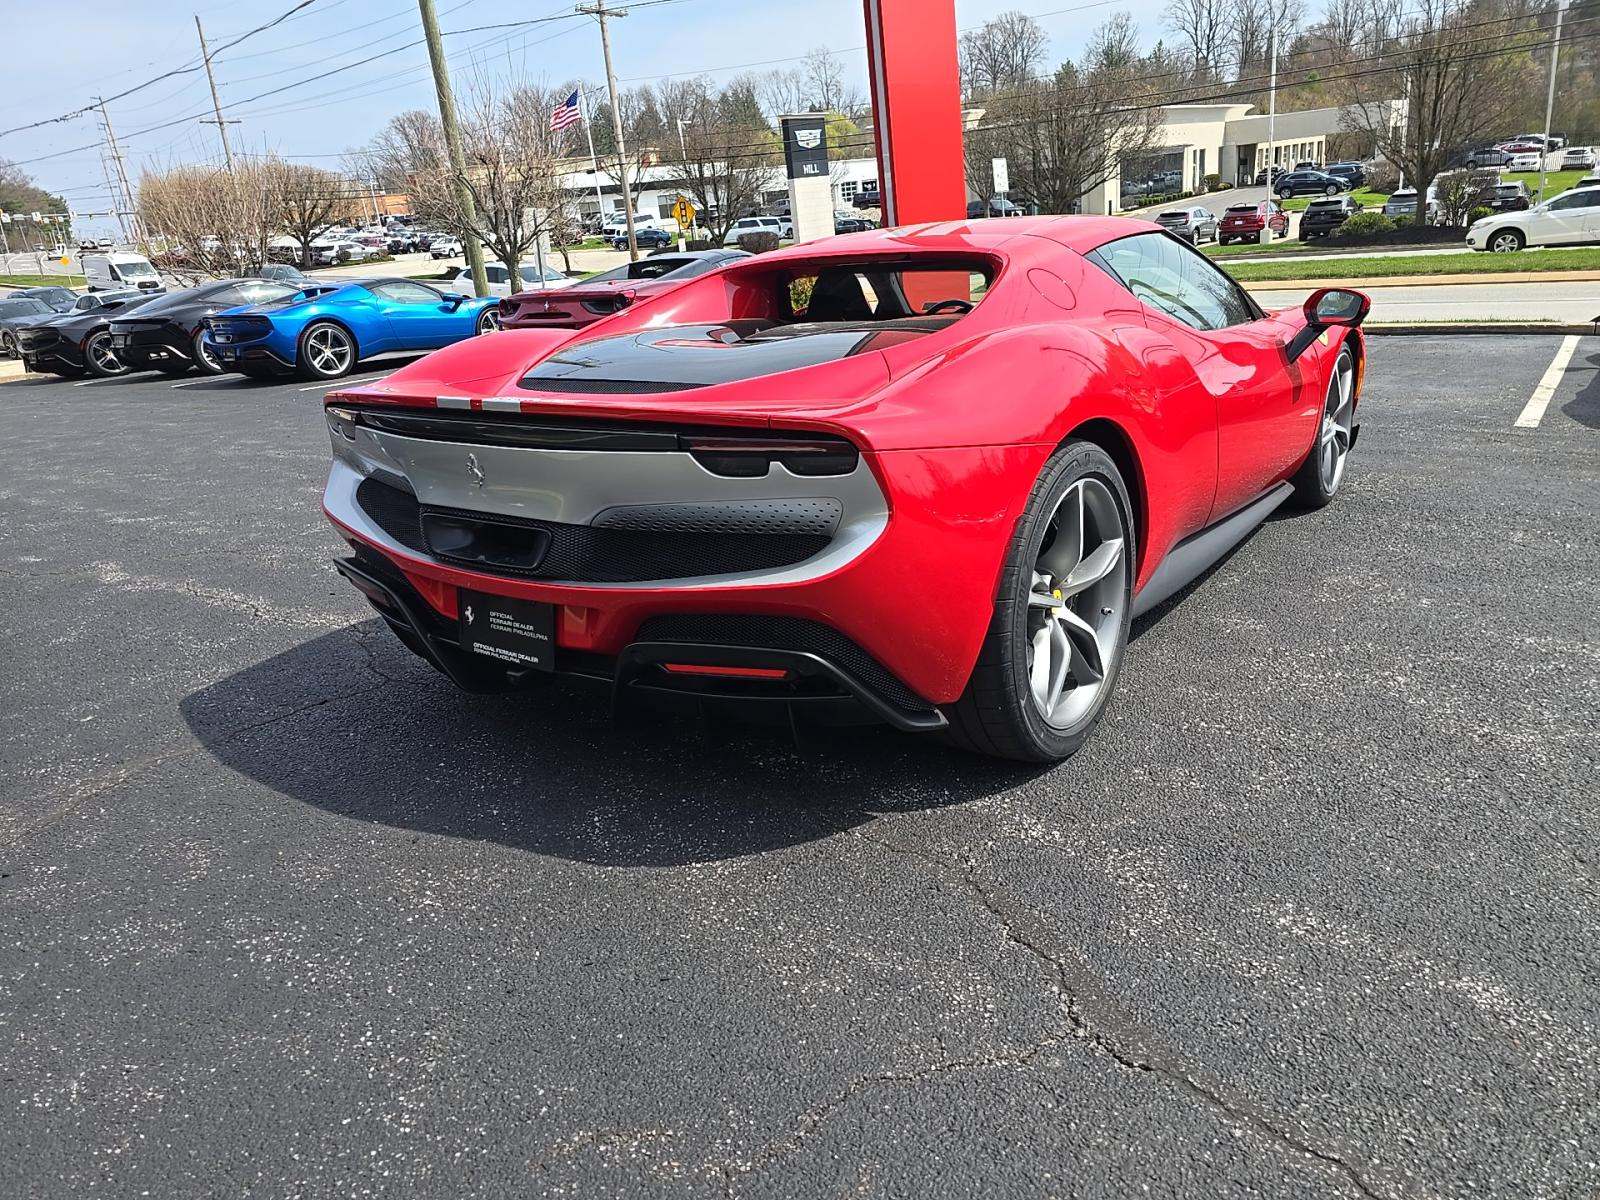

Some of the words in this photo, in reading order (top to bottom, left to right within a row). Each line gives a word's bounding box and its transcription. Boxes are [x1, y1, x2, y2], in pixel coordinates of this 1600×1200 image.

[803, 163, 820, 175] HILL
[490, 611, 514, 621] OFFICIAL
[489, 617, 513, 627] FERRARI
[513, 621, 534, 632] DEALER
[490, 623, 513, 633] FERRARI
[513, 628, 548, 641] PHILADELPHIA
[473, 642, 496, 653] OFFICIAL
[496, 648, 517, 657] FERRARI
[517, 653, 539, 663] DEALER
[473, 647, 491, 656] FERRARI
[490, 652, 520, 664] PHILADELPHIA
